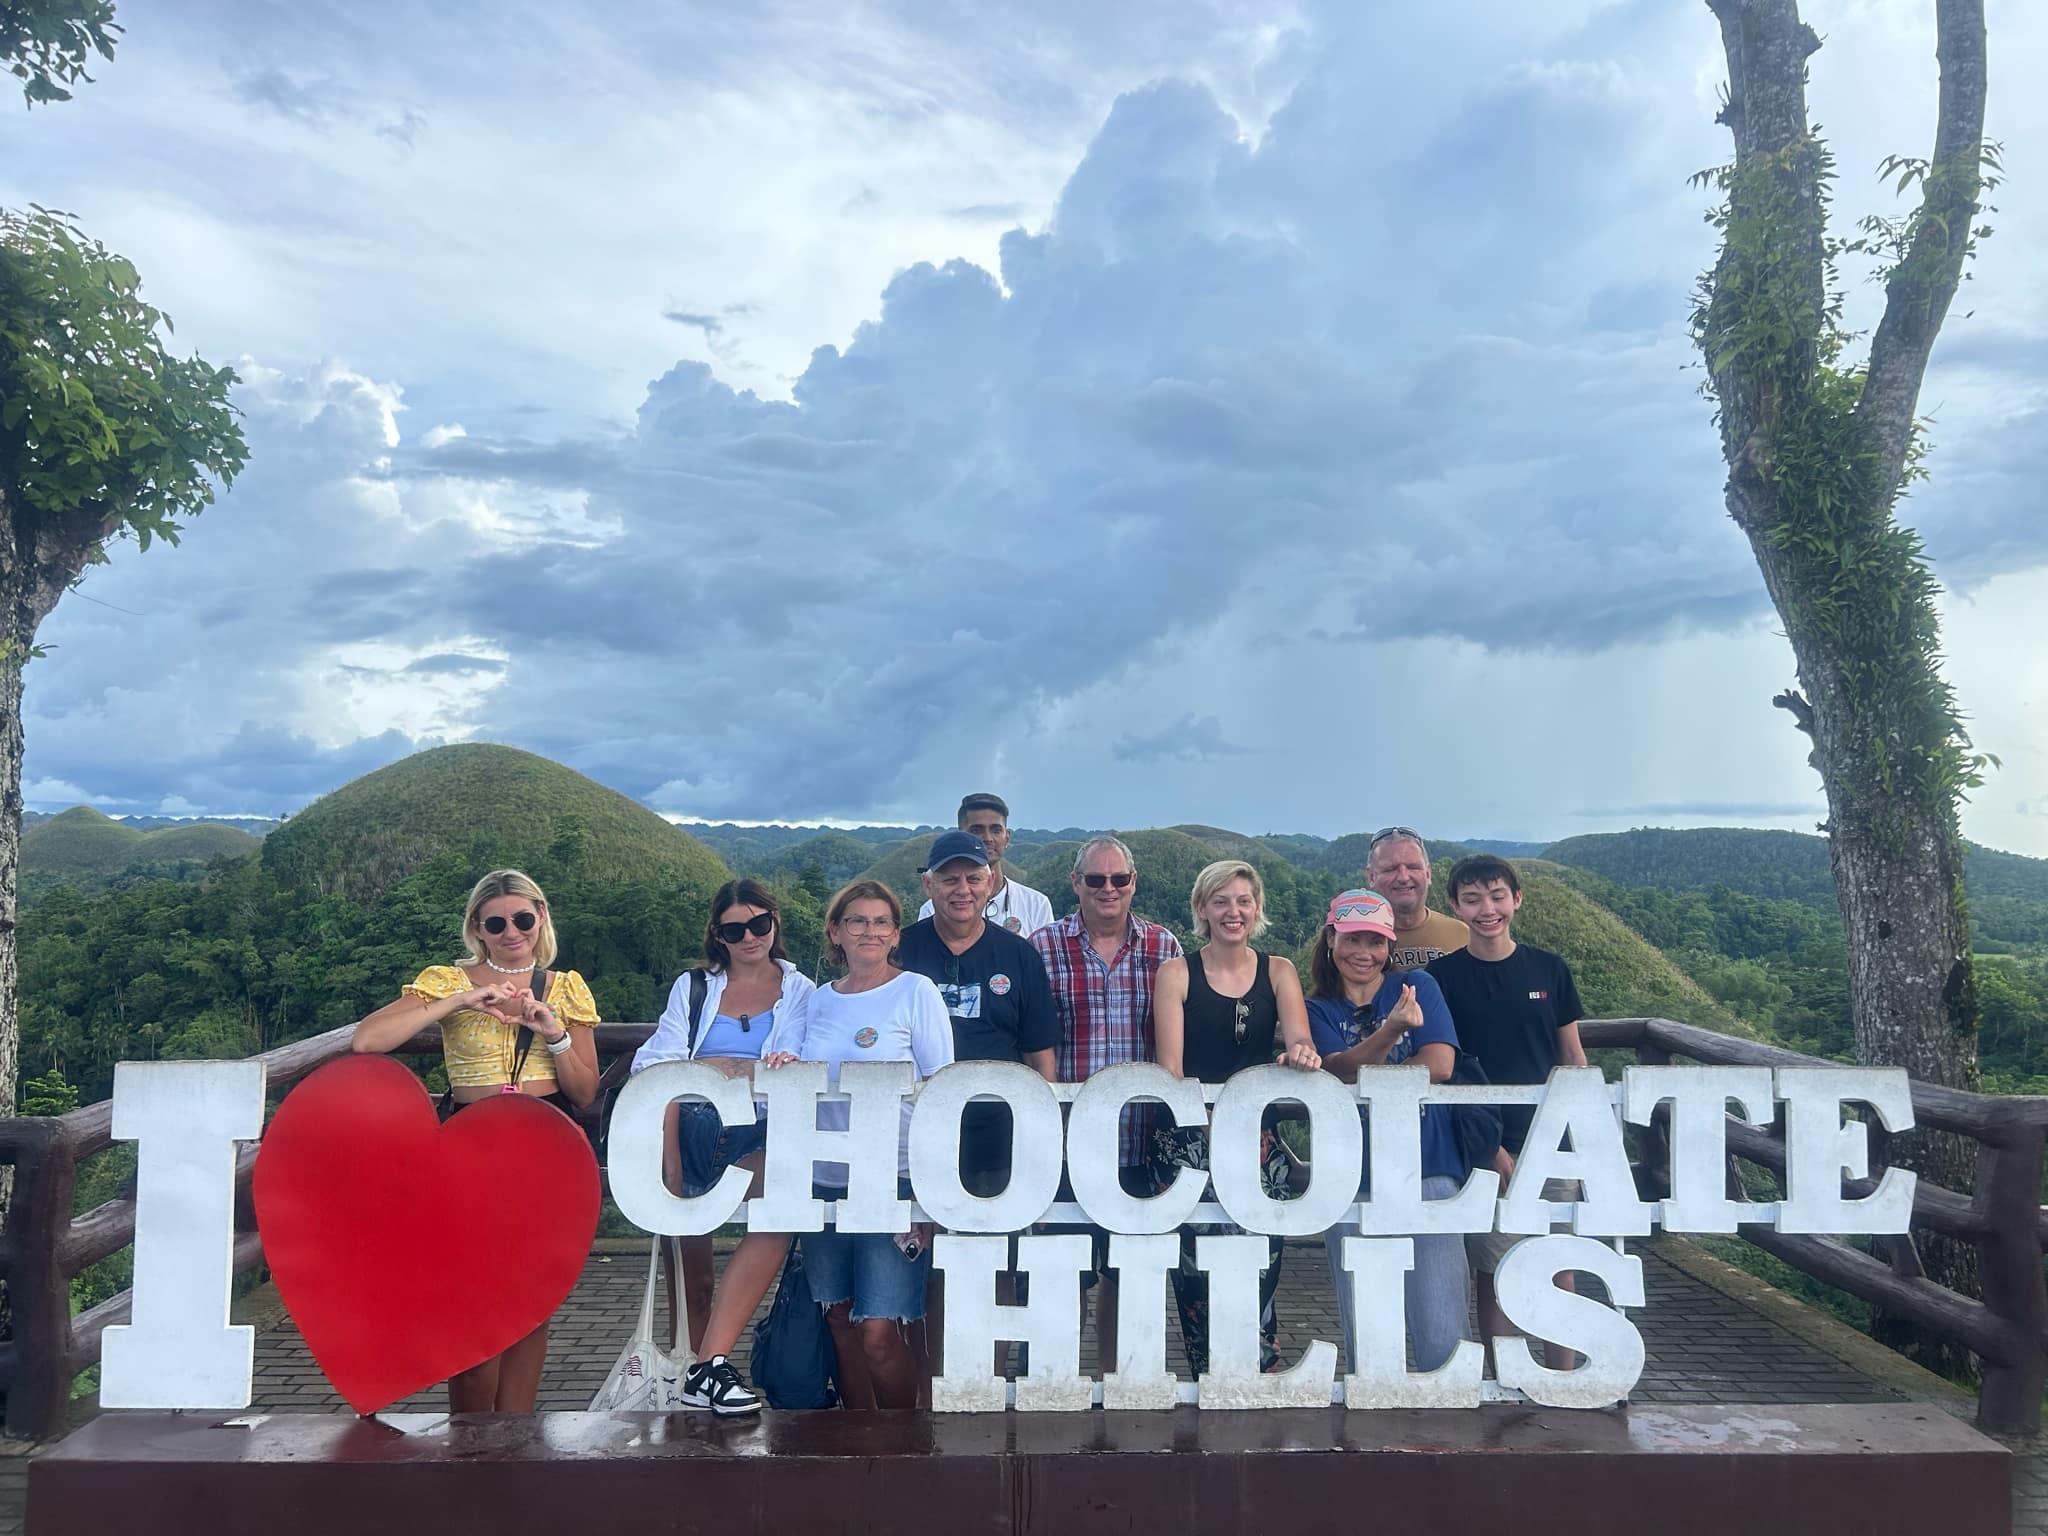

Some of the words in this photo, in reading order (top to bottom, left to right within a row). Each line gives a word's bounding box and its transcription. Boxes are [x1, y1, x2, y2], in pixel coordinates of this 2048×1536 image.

[99, 1060, 266, 1409] I
[607, 1060, 1917, 1237] CHOCOLATE
[931, 1234, 1646, 1412] HILLS
